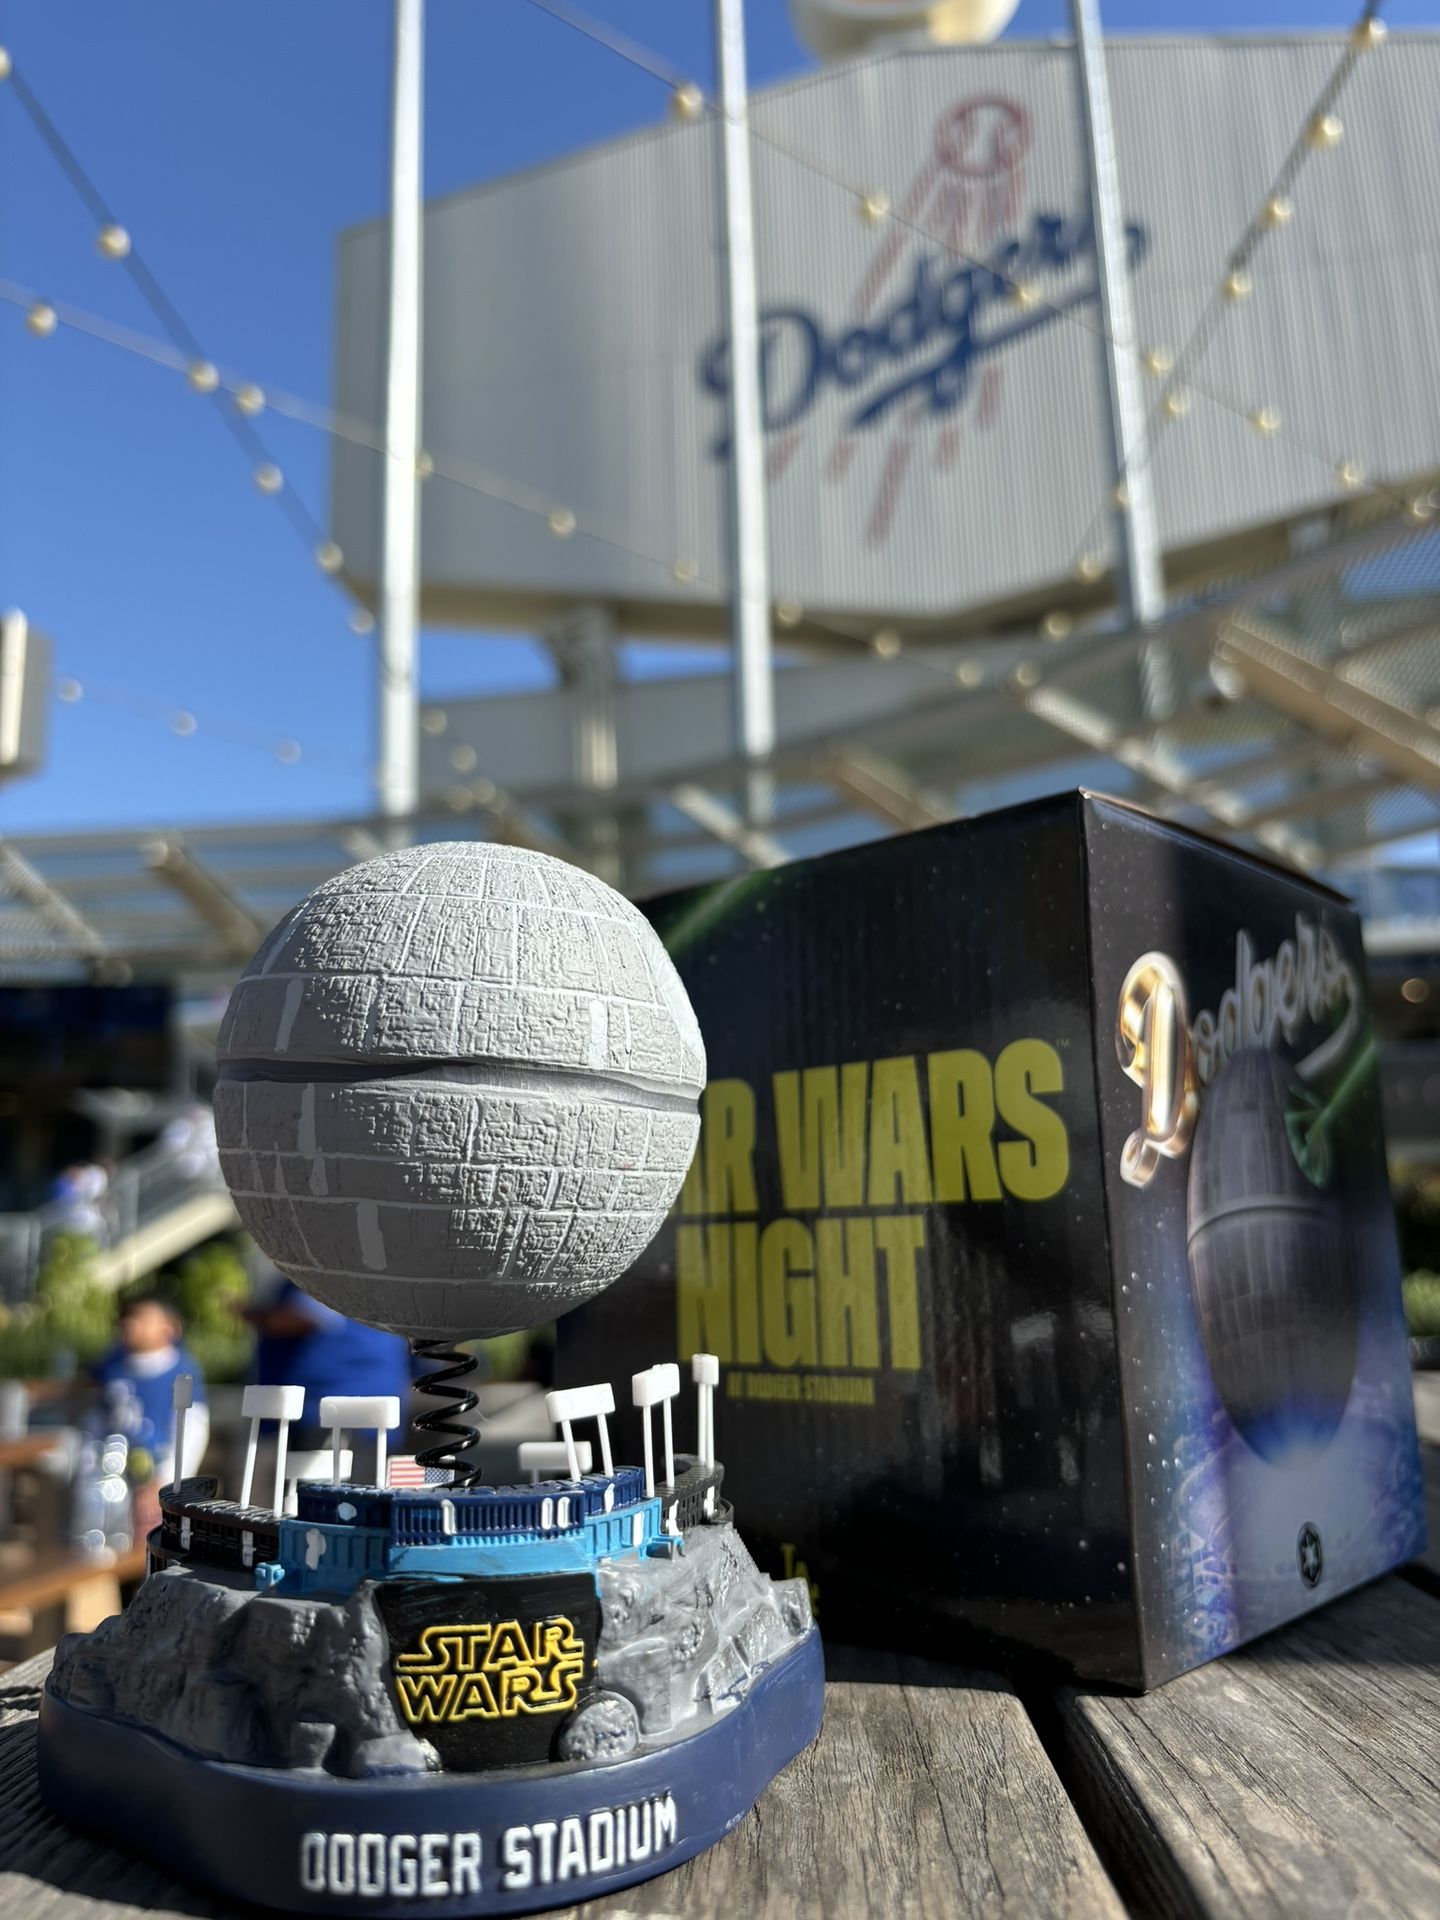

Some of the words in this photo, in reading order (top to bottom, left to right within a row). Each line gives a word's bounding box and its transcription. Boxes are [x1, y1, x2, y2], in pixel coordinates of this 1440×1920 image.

[698, 208, 1152, 466] Dodgers
[772, 1038, 1070, 1211] WARS
[1116, 908, 1361, 1189] Dodgers
[676, 1214, 926, 1371] NIGHT
[395, 1614, 585, 1673] STAR
[395, 1659, 585, 1724] WARS
[301, 1829, 483, 1898] DODGER
[503, 1792, 679, 1890] STADIUM
